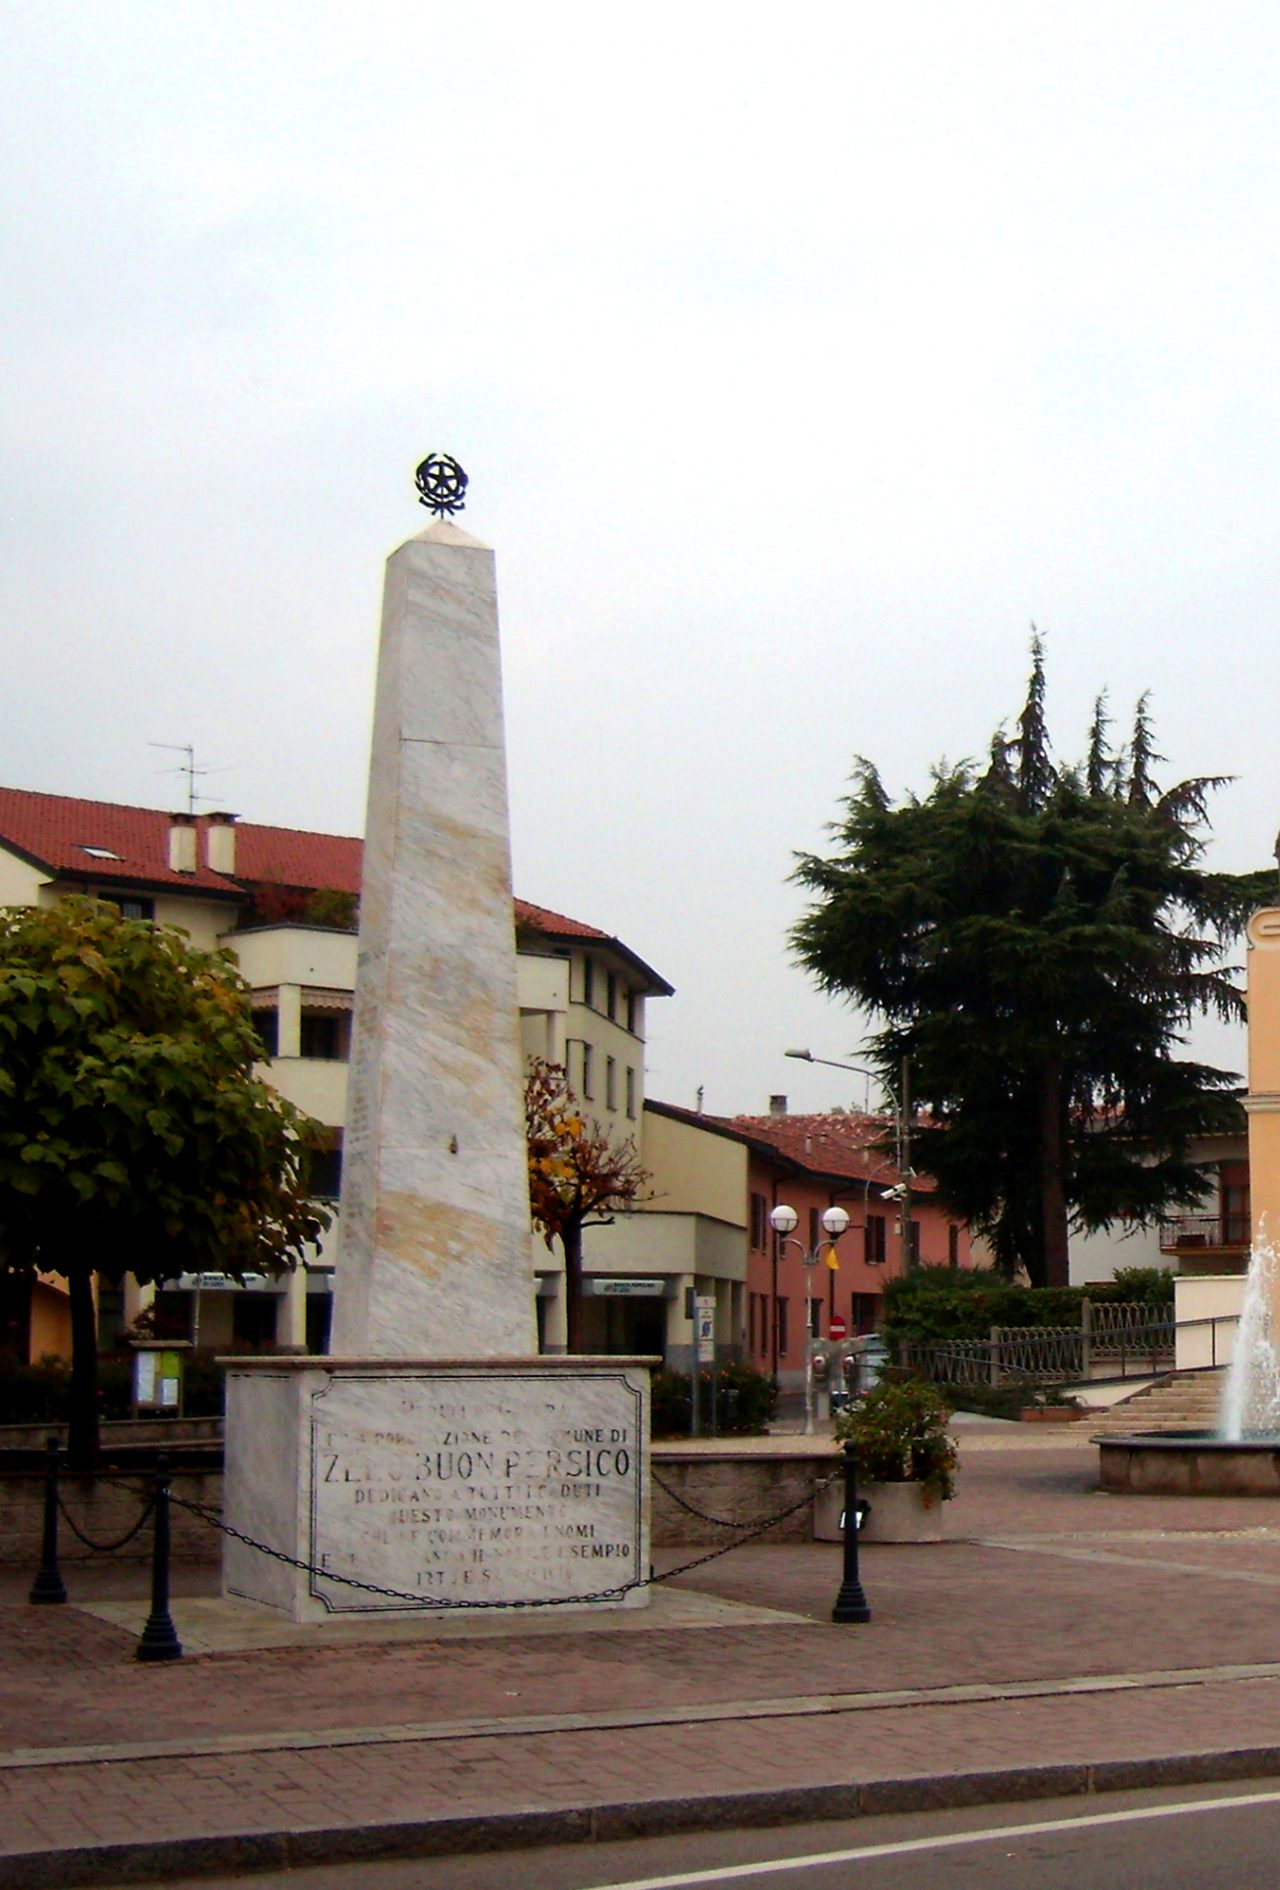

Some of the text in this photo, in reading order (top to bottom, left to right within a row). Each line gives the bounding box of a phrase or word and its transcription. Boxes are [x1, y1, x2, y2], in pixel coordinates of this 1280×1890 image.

[611, 1428, 627, 1443] DI
[416, 1451, 494, 1481] BUON
[506, 1449, 630, 1478] PERSICO
[555, 1523, 595, 1540] NOMI
